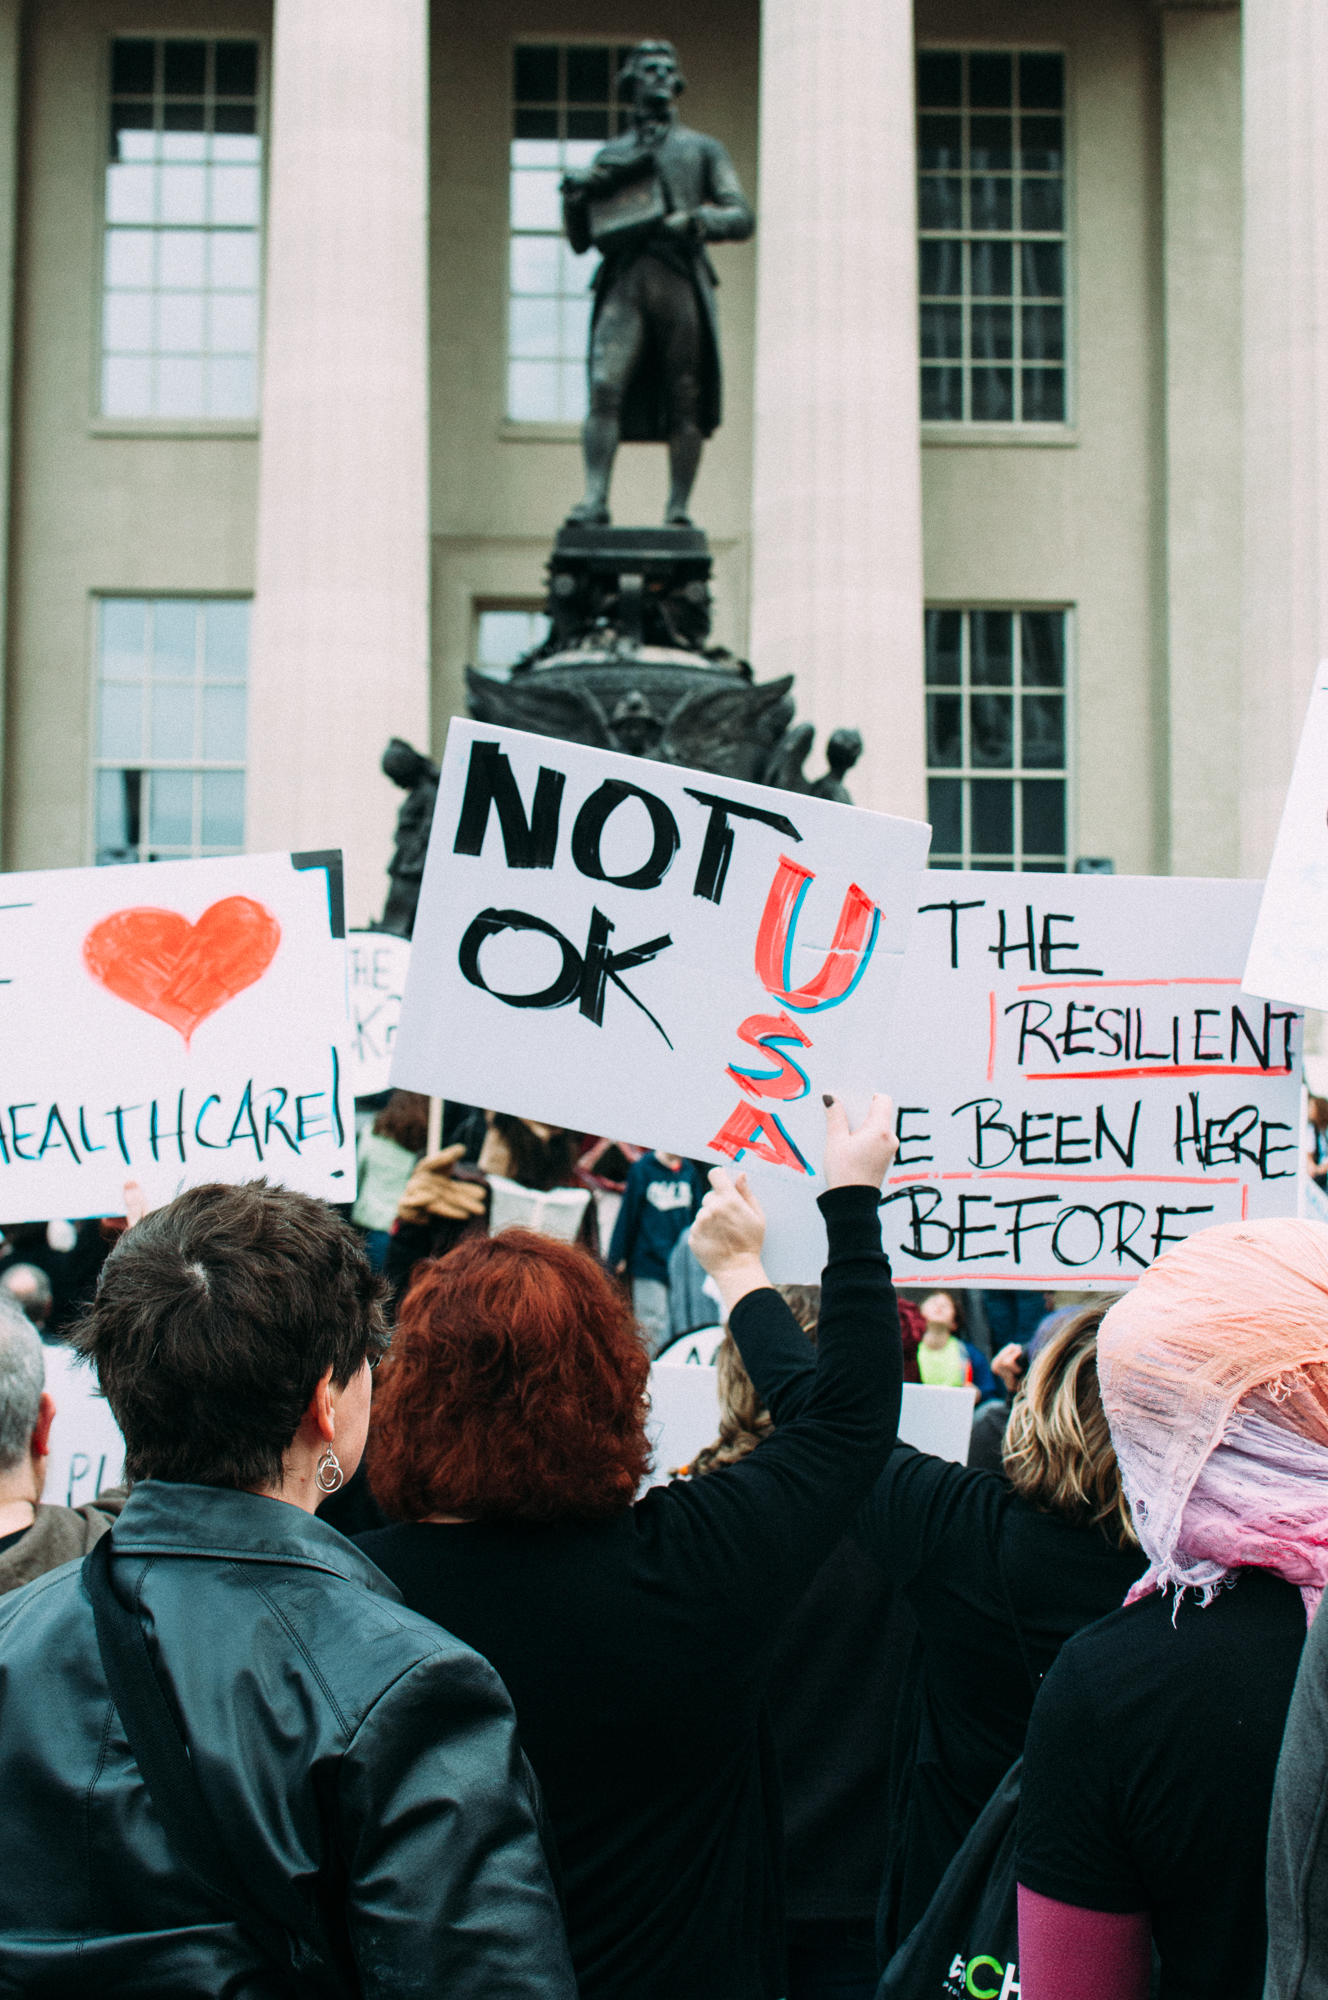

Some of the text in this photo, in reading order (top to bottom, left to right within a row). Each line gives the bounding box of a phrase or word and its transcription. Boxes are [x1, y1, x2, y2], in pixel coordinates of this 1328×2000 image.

[453, 740, 803, 905] NOT
[458, 904, 674, 1051] OK
[917, 900, 1103, 976] THE
[707, 853, 887, 1176] USA
[1004, 1001, 1304, 1071] RESILIENT
[951, 1097, 1142, 1169] BEEN
[1174, 1091, 1299, 1180] HERE
[878, 1185, 1215, 1268] BEFORE
